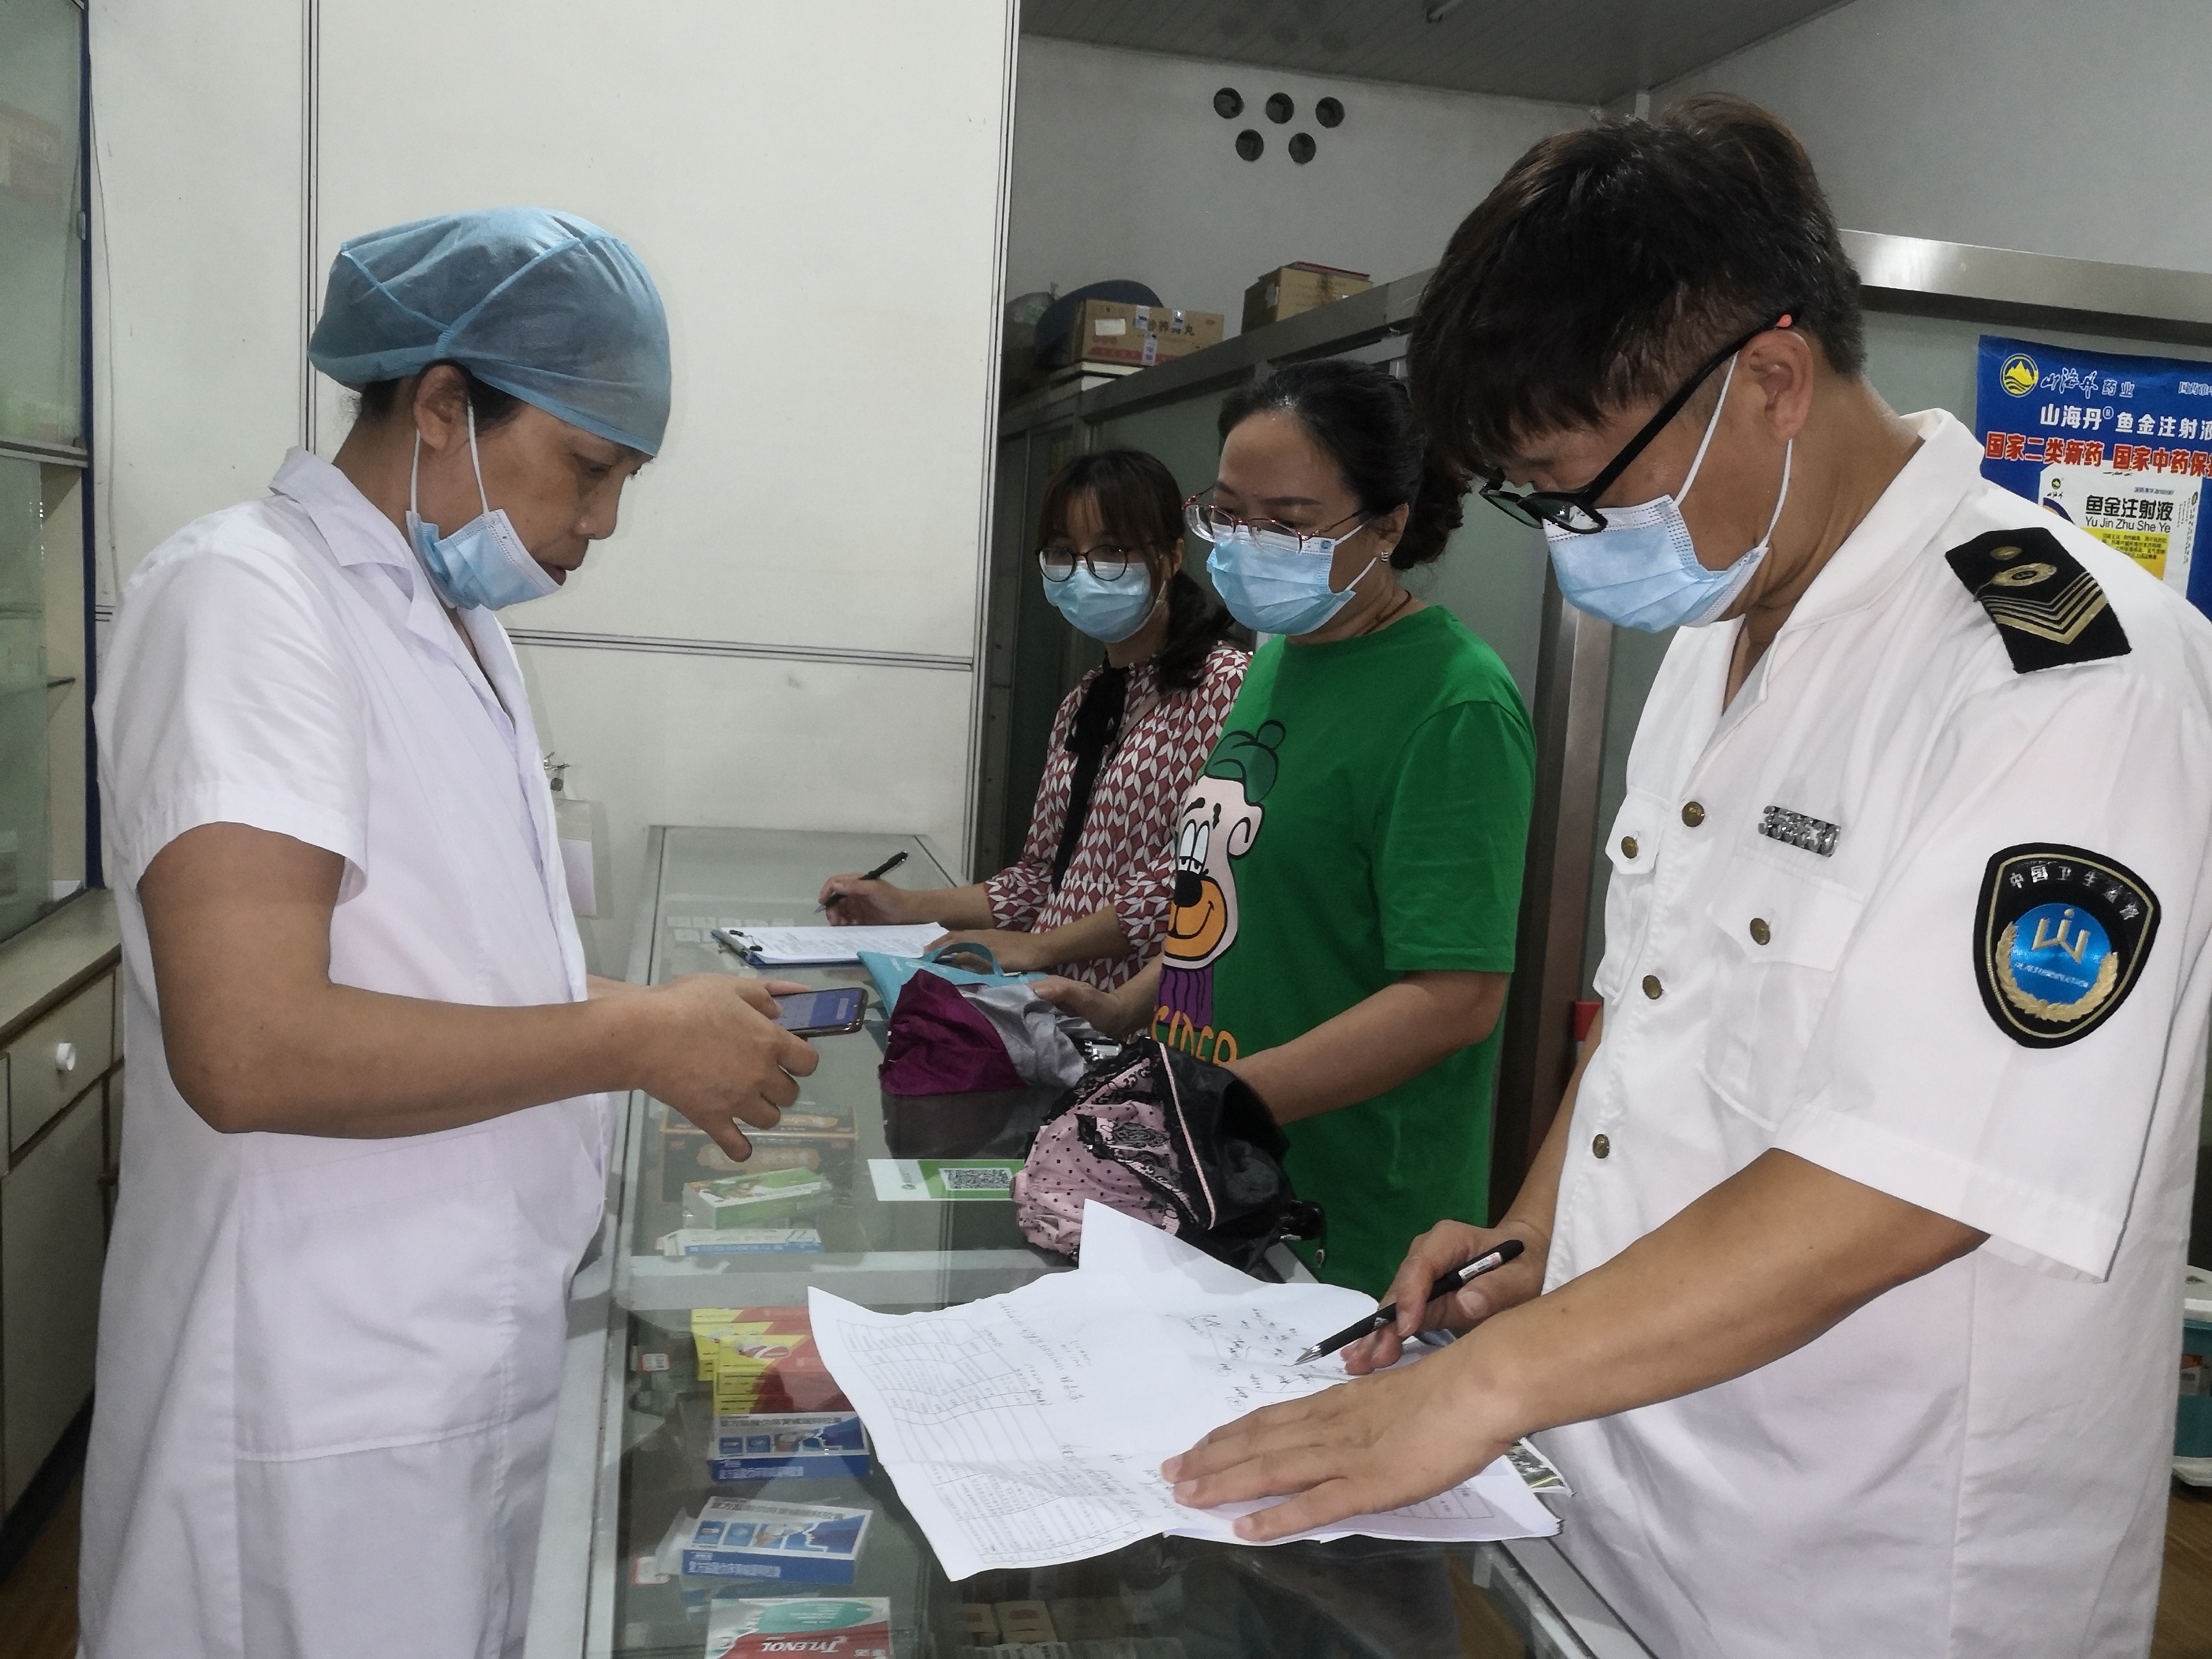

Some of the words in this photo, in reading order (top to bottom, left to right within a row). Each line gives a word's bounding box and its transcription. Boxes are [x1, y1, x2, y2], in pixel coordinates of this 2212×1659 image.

[1985, 431, 2105, 467] 国家二类新药
[2085, 494, 2174, 521] 鱼金注射液
[2085, 515, 2098, 527] Yu
[2100, 517, 2114, 529] Jin
[2115, 519, 2135, 531] Zhu
[2137, 520, 2156, 532] She
[2158, 521, 2171, 534] Ye
